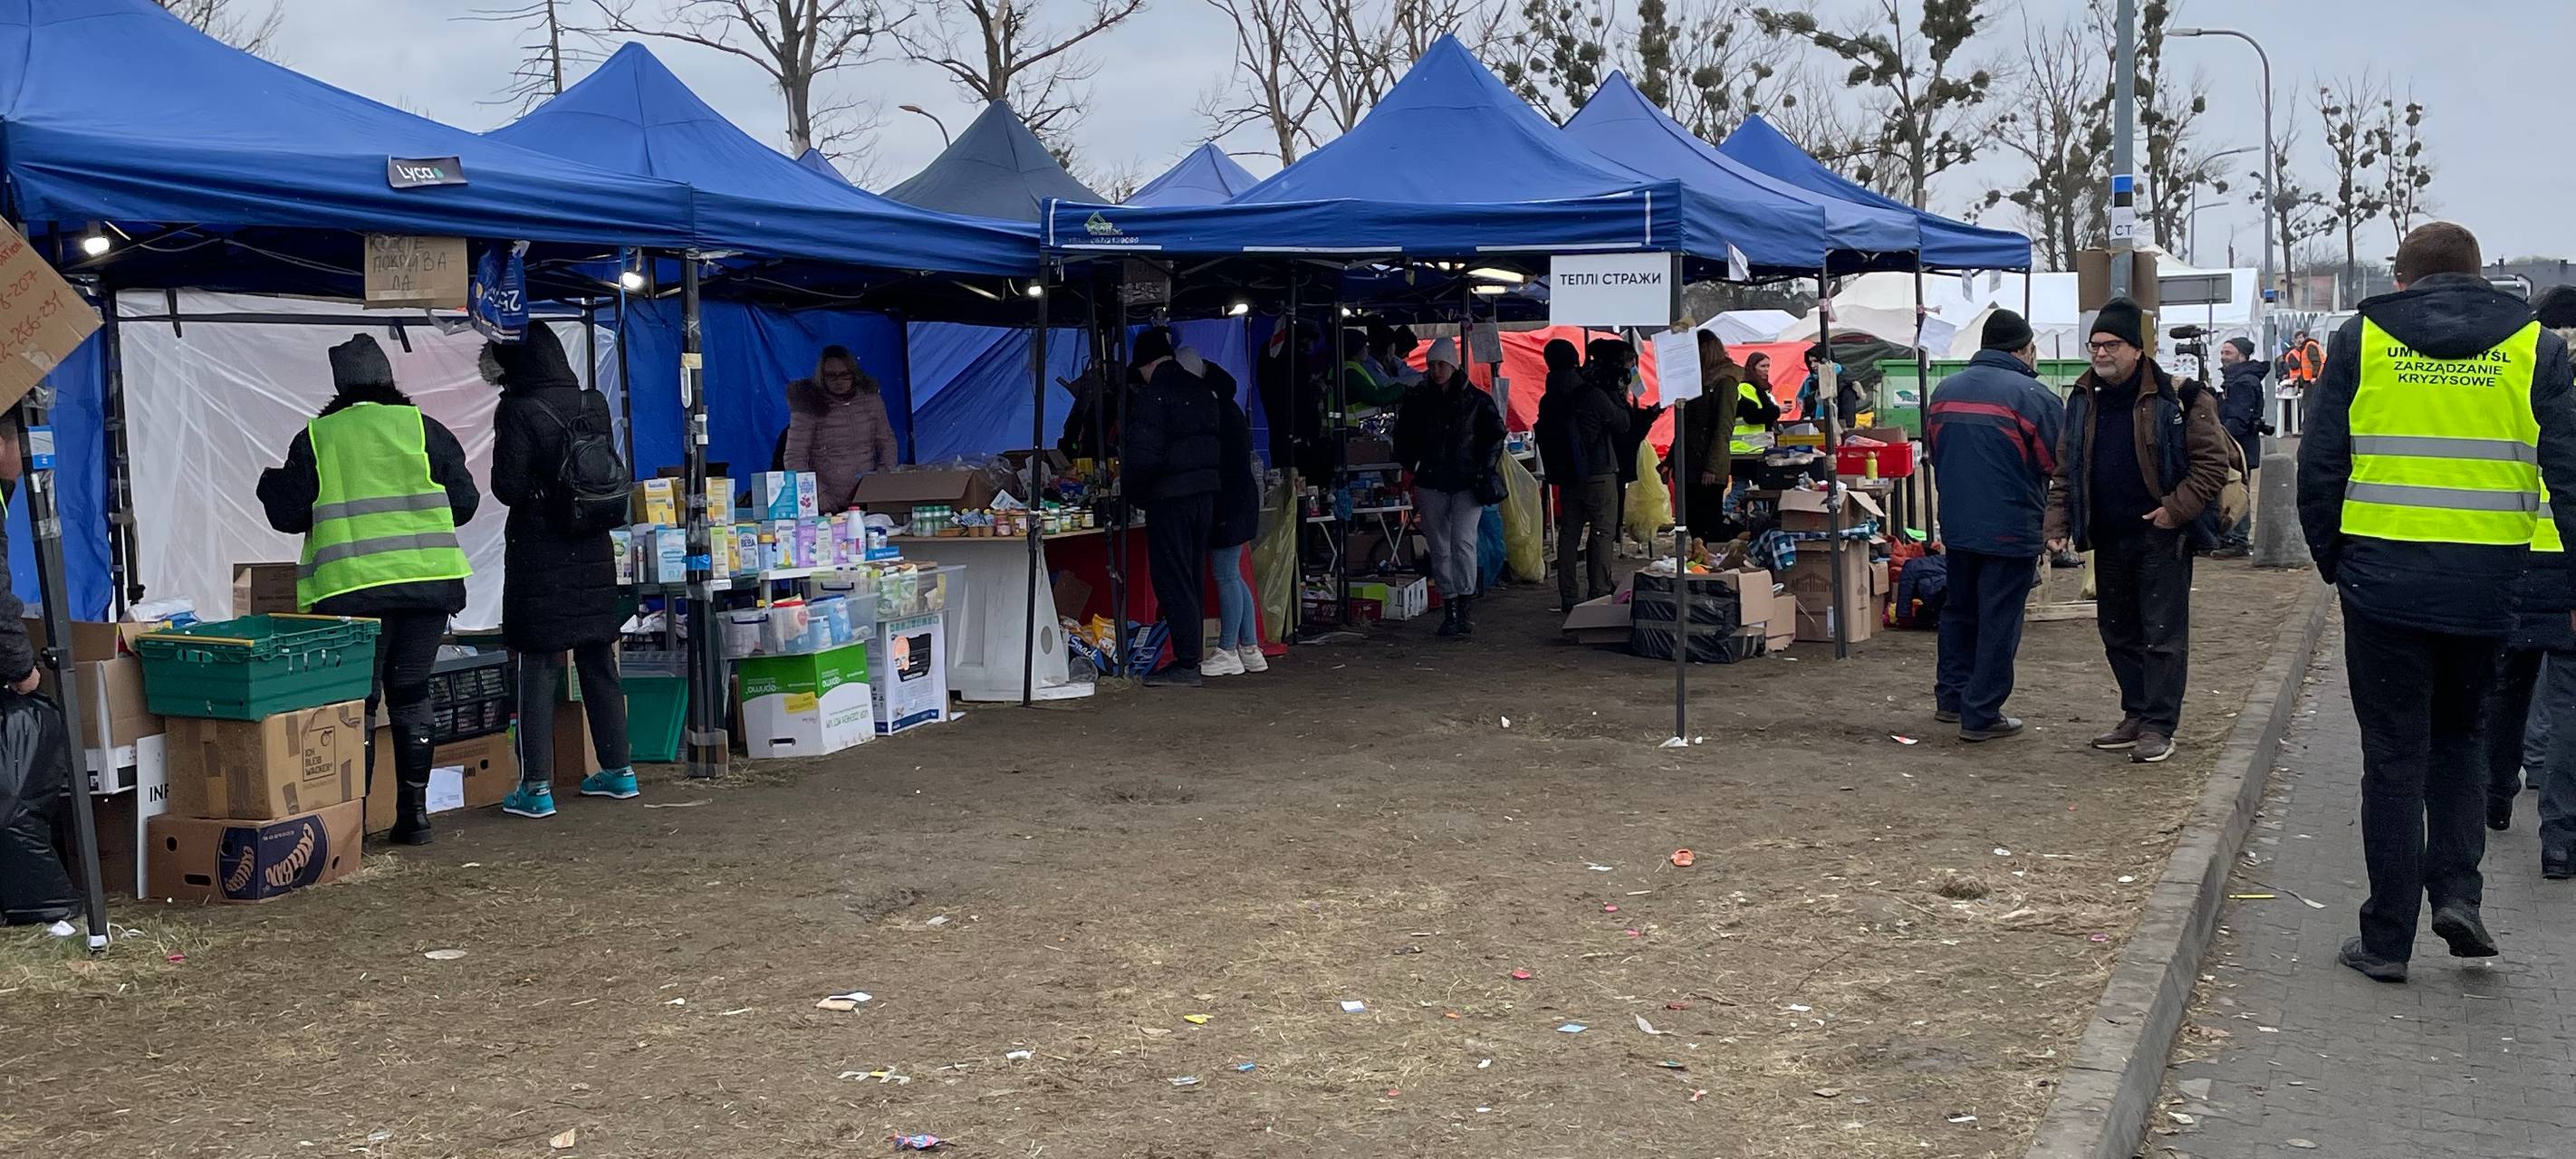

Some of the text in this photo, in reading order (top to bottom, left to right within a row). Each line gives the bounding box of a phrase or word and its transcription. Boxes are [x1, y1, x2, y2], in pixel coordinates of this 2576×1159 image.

[396, 164, 436, 182] Lyca
[1560, 273, 1661, 285] ТЕПЛІ СТРАЖИ
[2387, 347, 2413, 358] UM
[2393, 361, 2503, 376] ZARZĄDZANIE
[2398, 373, 2495, 387] KRYZYSOWE
[1069, 636, 1098, 661] Snack
[747, 684, 776, 694] eprimo
